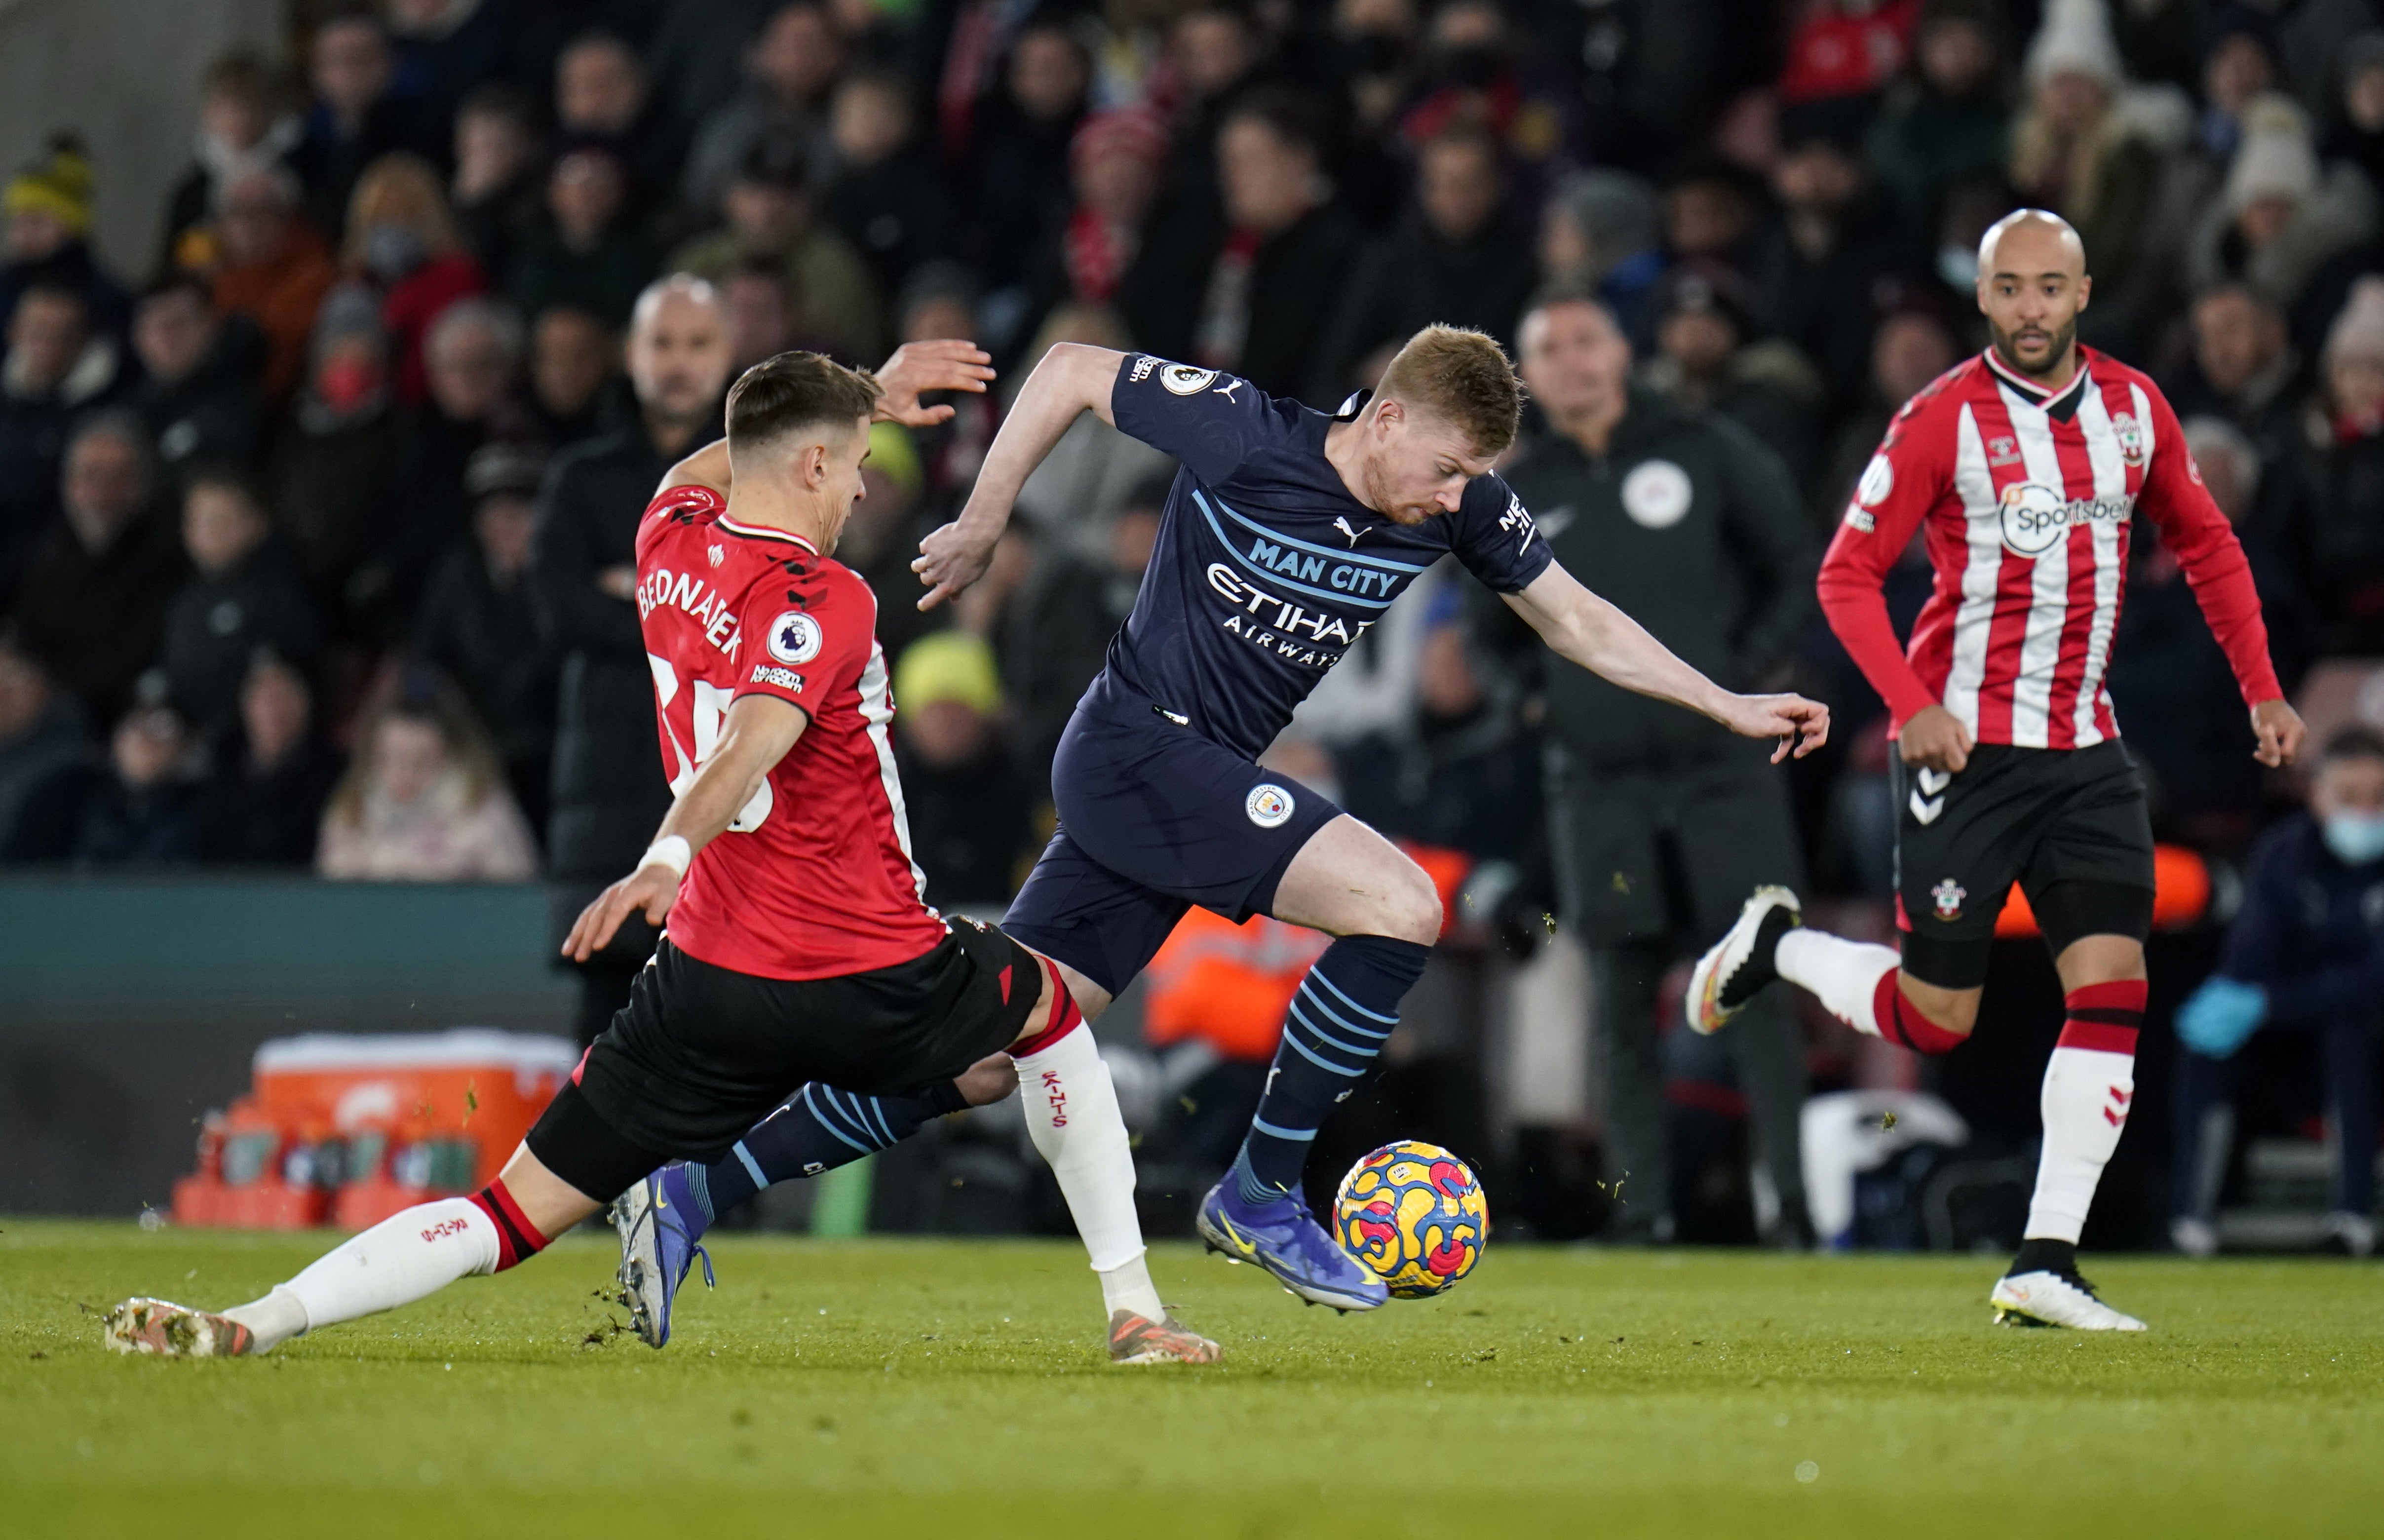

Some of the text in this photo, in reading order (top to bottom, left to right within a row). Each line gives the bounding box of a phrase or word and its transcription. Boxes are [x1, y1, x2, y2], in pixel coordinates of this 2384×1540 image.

[1248, 538, 1399, 597] MAN CITY
[1248, 786, 1276, 815] MANCHESTER
[1280, 808, 1291, 820] CITY
[1041, 1071, 1068, 1128] SAINTS
[421, 1218, 469, 1242] SAINTS
